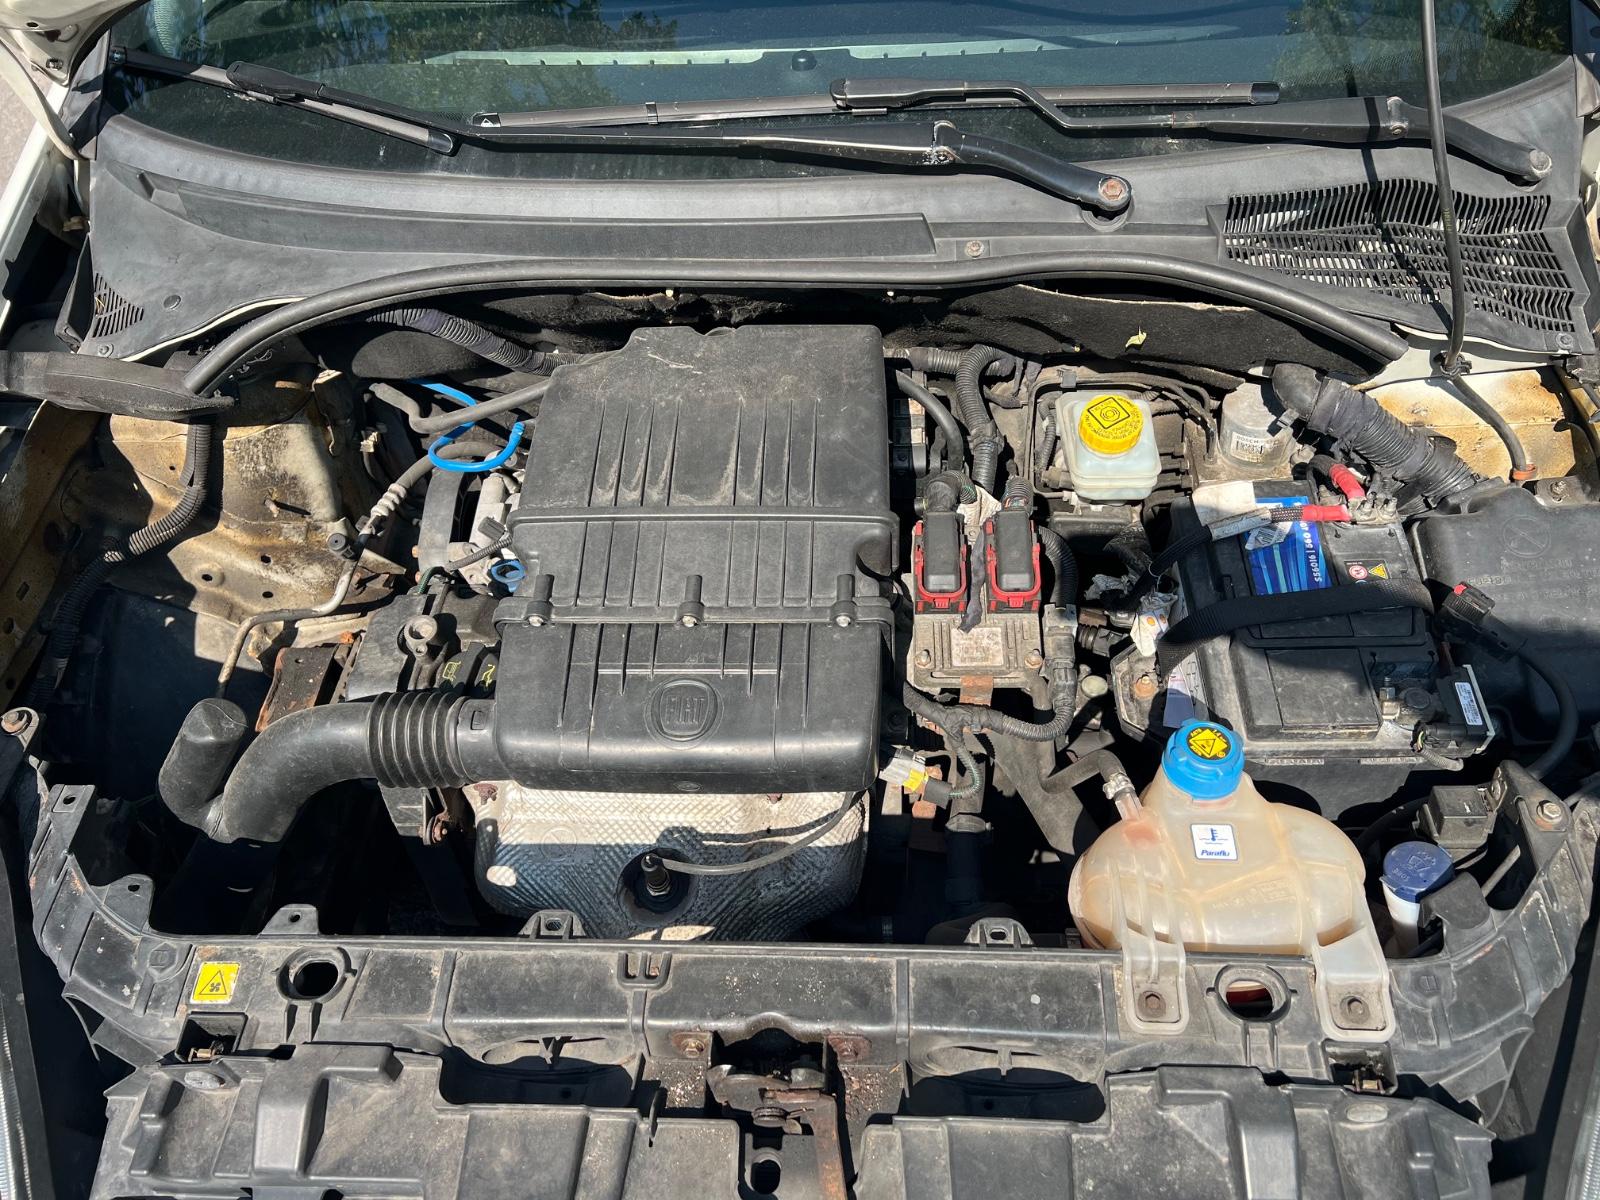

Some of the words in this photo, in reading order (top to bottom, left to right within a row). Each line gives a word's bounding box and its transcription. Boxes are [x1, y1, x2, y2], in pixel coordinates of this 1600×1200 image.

[1303, 532, 1314, 548] 560
[665, 695, 705, 725] FIAT
[1201, 849, 1230, 857] Paraflu
